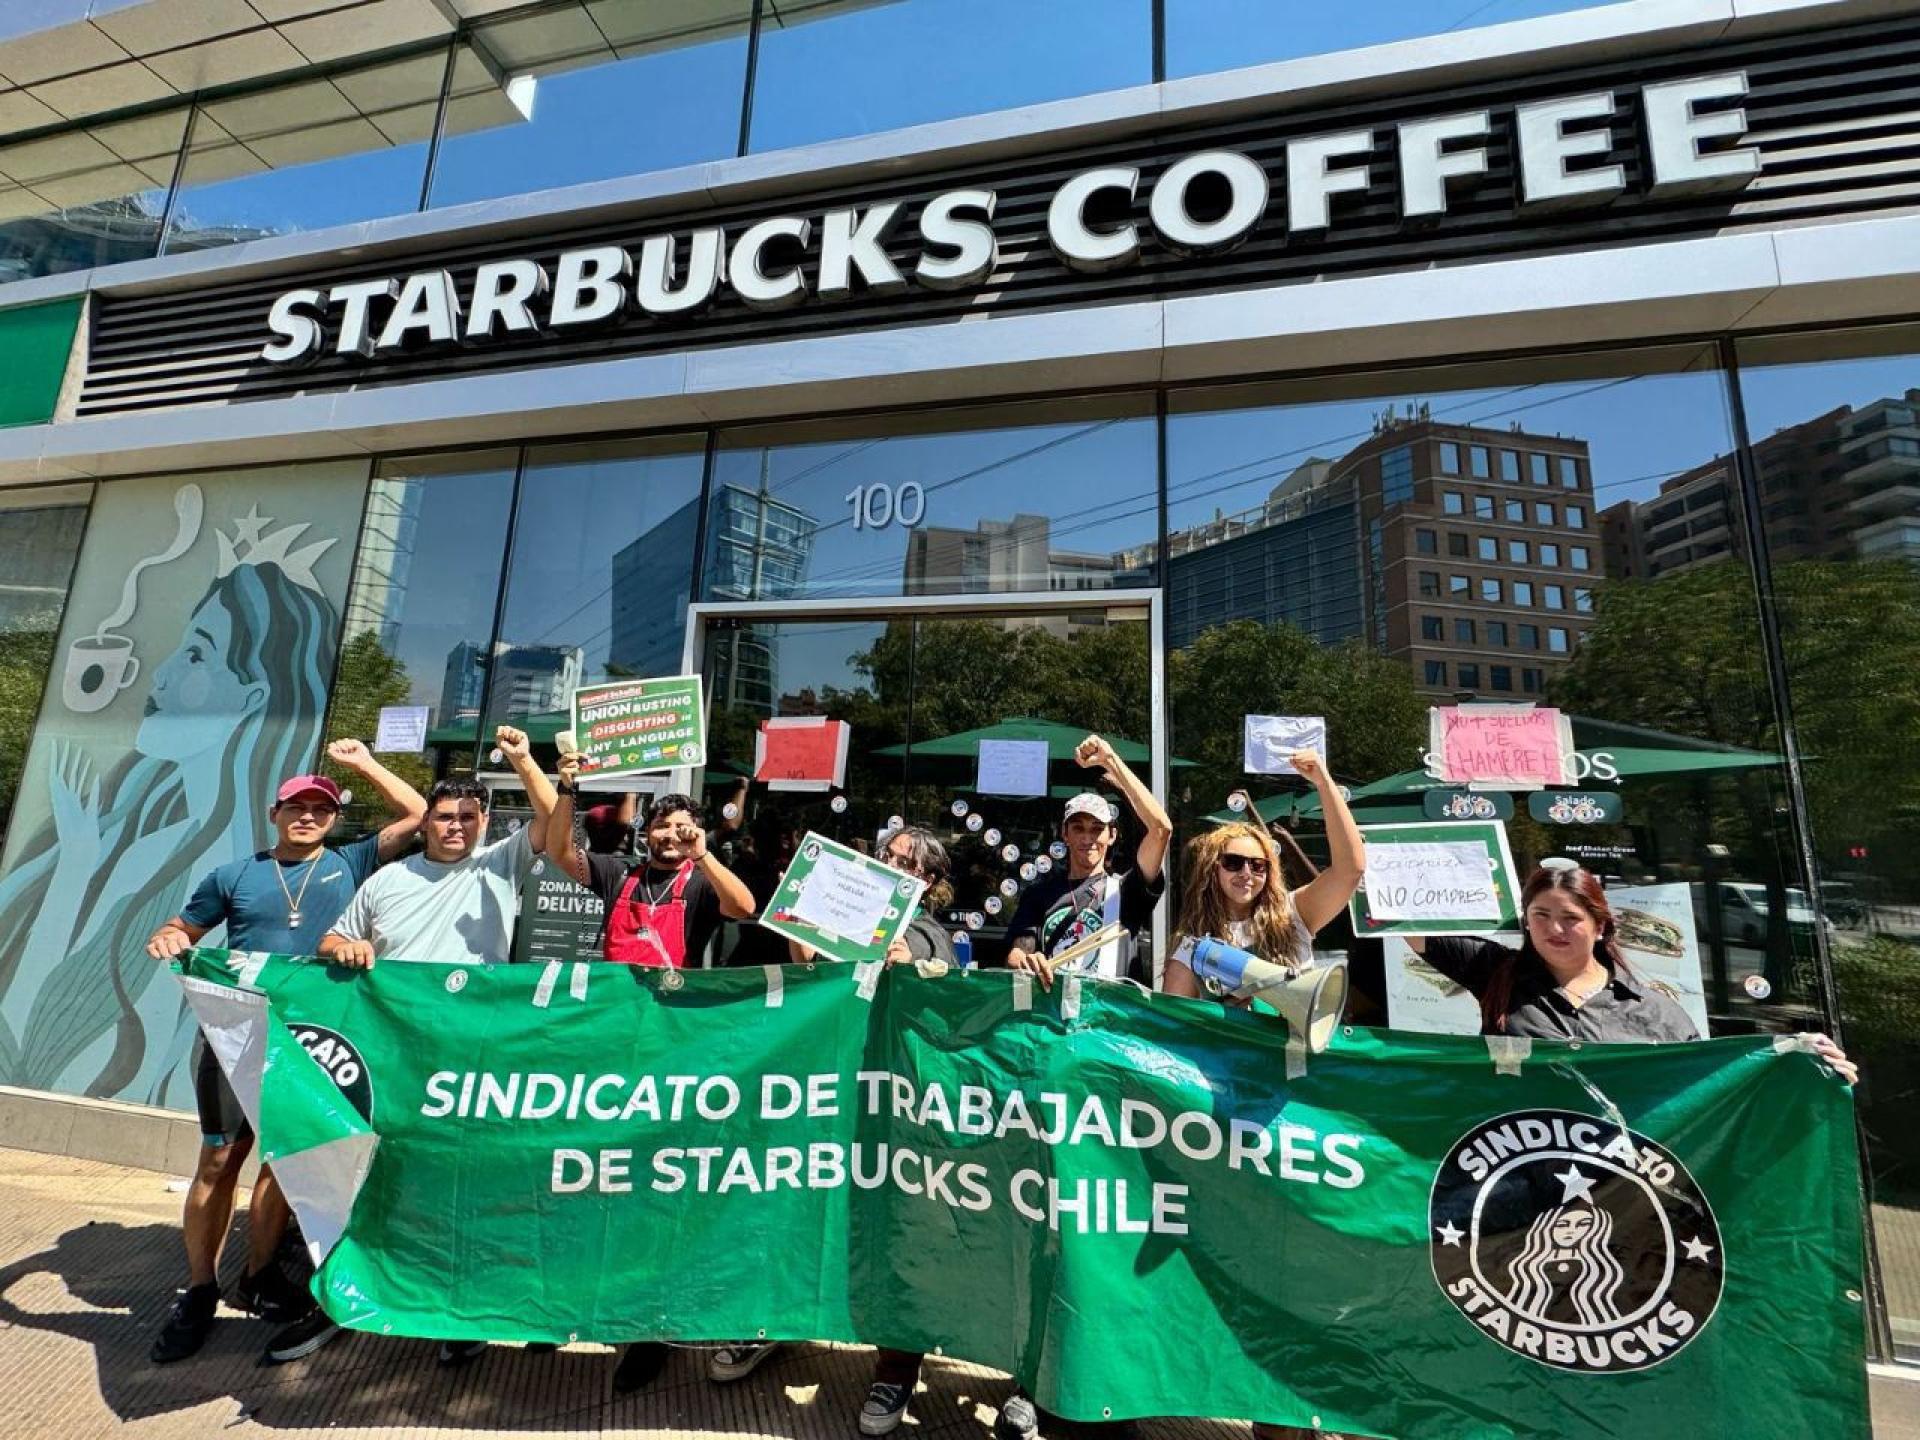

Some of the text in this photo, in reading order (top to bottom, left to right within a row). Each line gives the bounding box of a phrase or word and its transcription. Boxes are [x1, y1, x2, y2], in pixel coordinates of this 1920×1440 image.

[262, 70, 1762, 364] STARBUCKS COFFEE
[845, 481, 925, 529] 100
[581, 703, 631, 723] UNION
[632, 695, 692, 713] BUSTING
[595, 714, 676, 737] DISGUSTING
[1485, 732, 1511, 746] DE
[586, 727, 694, 754] ANY LANGUAGE
[1555, 795, 1596, 806] Salado
[539, 881, 574, 894] ZONA
[1376, 885, 1407, 907] NO
[420, 1070, 1366, 1190] SINDICATO DE TRABAJADORES
[1457, 1118, 1676, 1187] SINDICATO
[551, 1142, 1190, 1235] DE STARBUCKS CHILE
[1448, 1276, 1695, 1367] STARBUCKS
